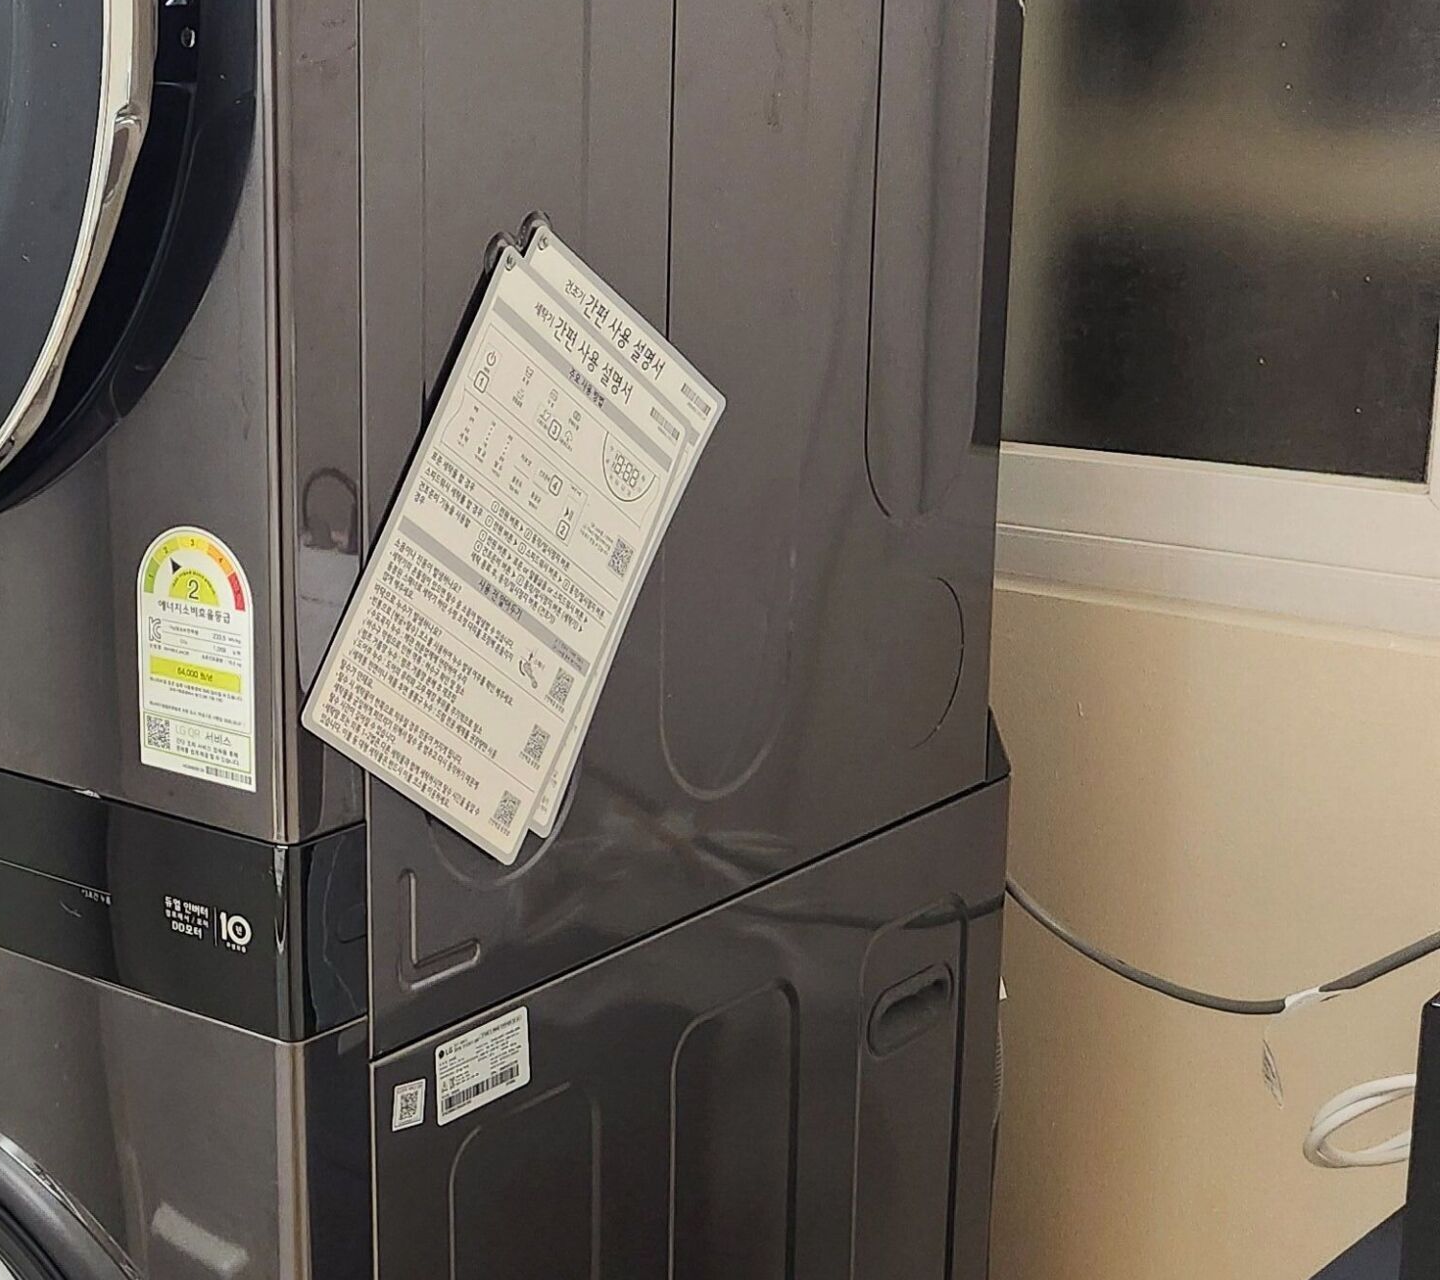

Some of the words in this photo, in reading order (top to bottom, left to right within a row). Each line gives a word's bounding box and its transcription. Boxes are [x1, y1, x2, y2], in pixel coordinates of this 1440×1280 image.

[564, 278, 587, 306] 건조기
[583, 294, 611, 330] 간편
[607, 317, 632, 349] 사용
[630, 339, 666, 381] 설명서
[534, 301, 556, 328] 세탁기
[553, 316, 579, 353] 간편
[577, 340, 600, 373] 사용
[600, 362, 634, 405] 설명서
[187, 577, 200, 602] 2
[157, 600, 231, 625] 에너지소비효율등급
[204, 729, 231, 746] 서비스
[183, 900, 209, 919] 인버터
[171, 920, 203, 940] DD모터
[219, 910, 252, 946] 10
